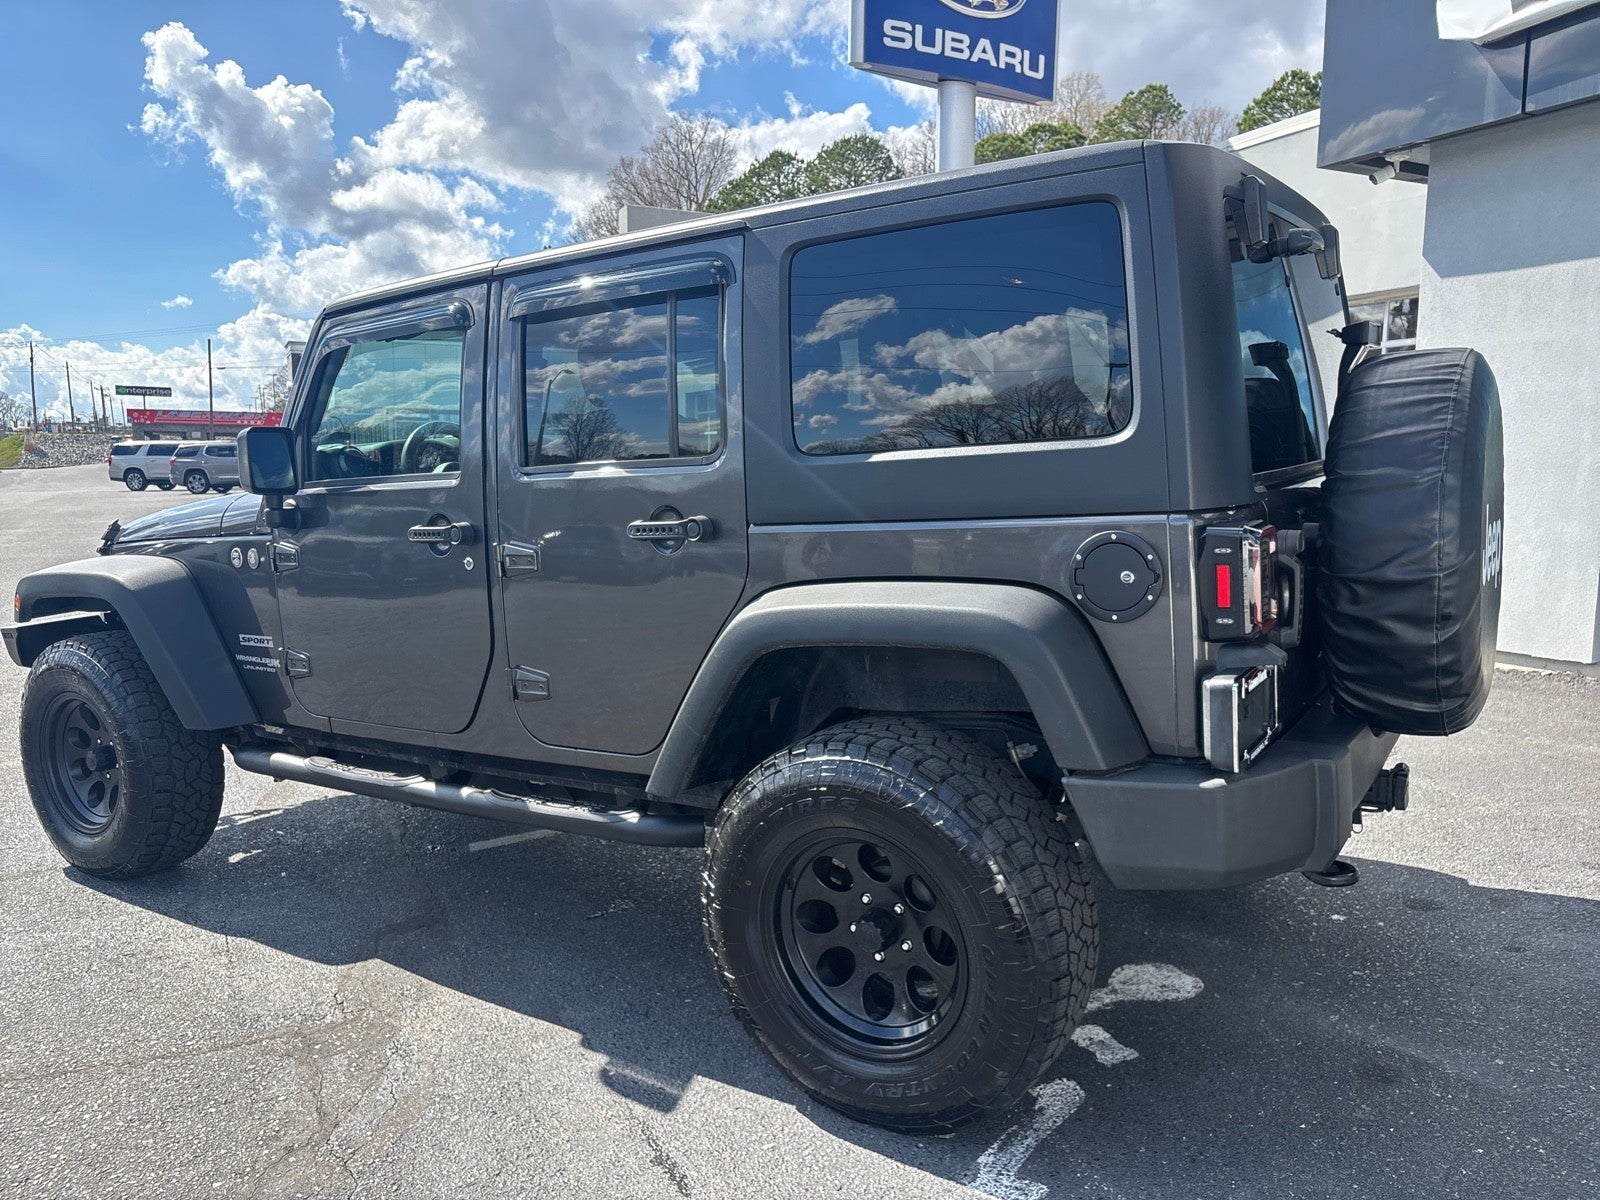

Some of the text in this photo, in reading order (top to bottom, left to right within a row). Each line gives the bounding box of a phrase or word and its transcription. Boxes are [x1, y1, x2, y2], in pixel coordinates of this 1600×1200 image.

[883, 18, 1045, 80] SUBARU
[117, 387, 171, 396] enterprise
[1482, 503, 1502, 589] Jeep
[241, 636, 271, 645] SPORT
[243, 664, 275, 672] UNLIMITED
[863, 1036, 982, 1099] COUNTRY
